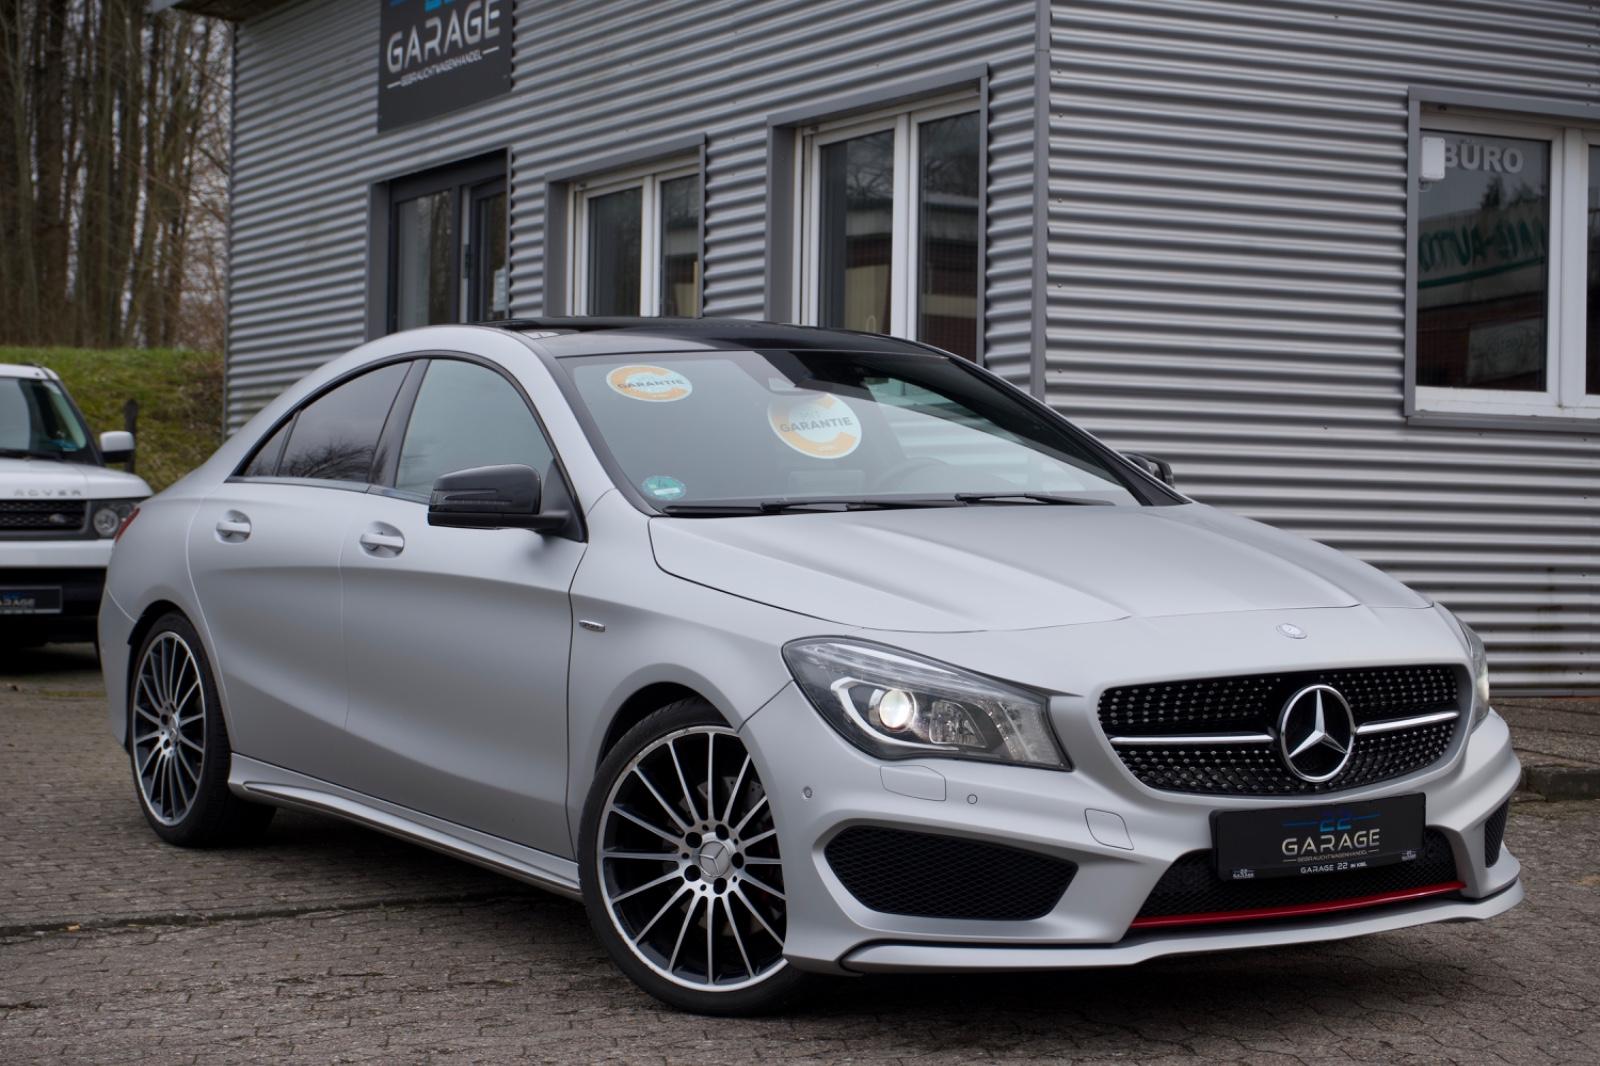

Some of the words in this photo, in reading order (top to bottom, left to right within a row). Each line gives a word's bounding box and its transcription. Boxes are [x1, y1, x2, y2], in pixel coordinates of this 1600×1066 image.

[387, 0, 500, 73] GARAGE
[1445, 139, 1524, 173] BÜRO
[617, 380, 684, 389] GARANTIE
[781, 416, 853, 433] GARANTIE
[14, 488, 81, 497] ROVER
[1282, 828, 1381, 856] GARAGE
[1300, 864, 1334, 874] GARAGE
[1337, 862, 1348, 870] 22
